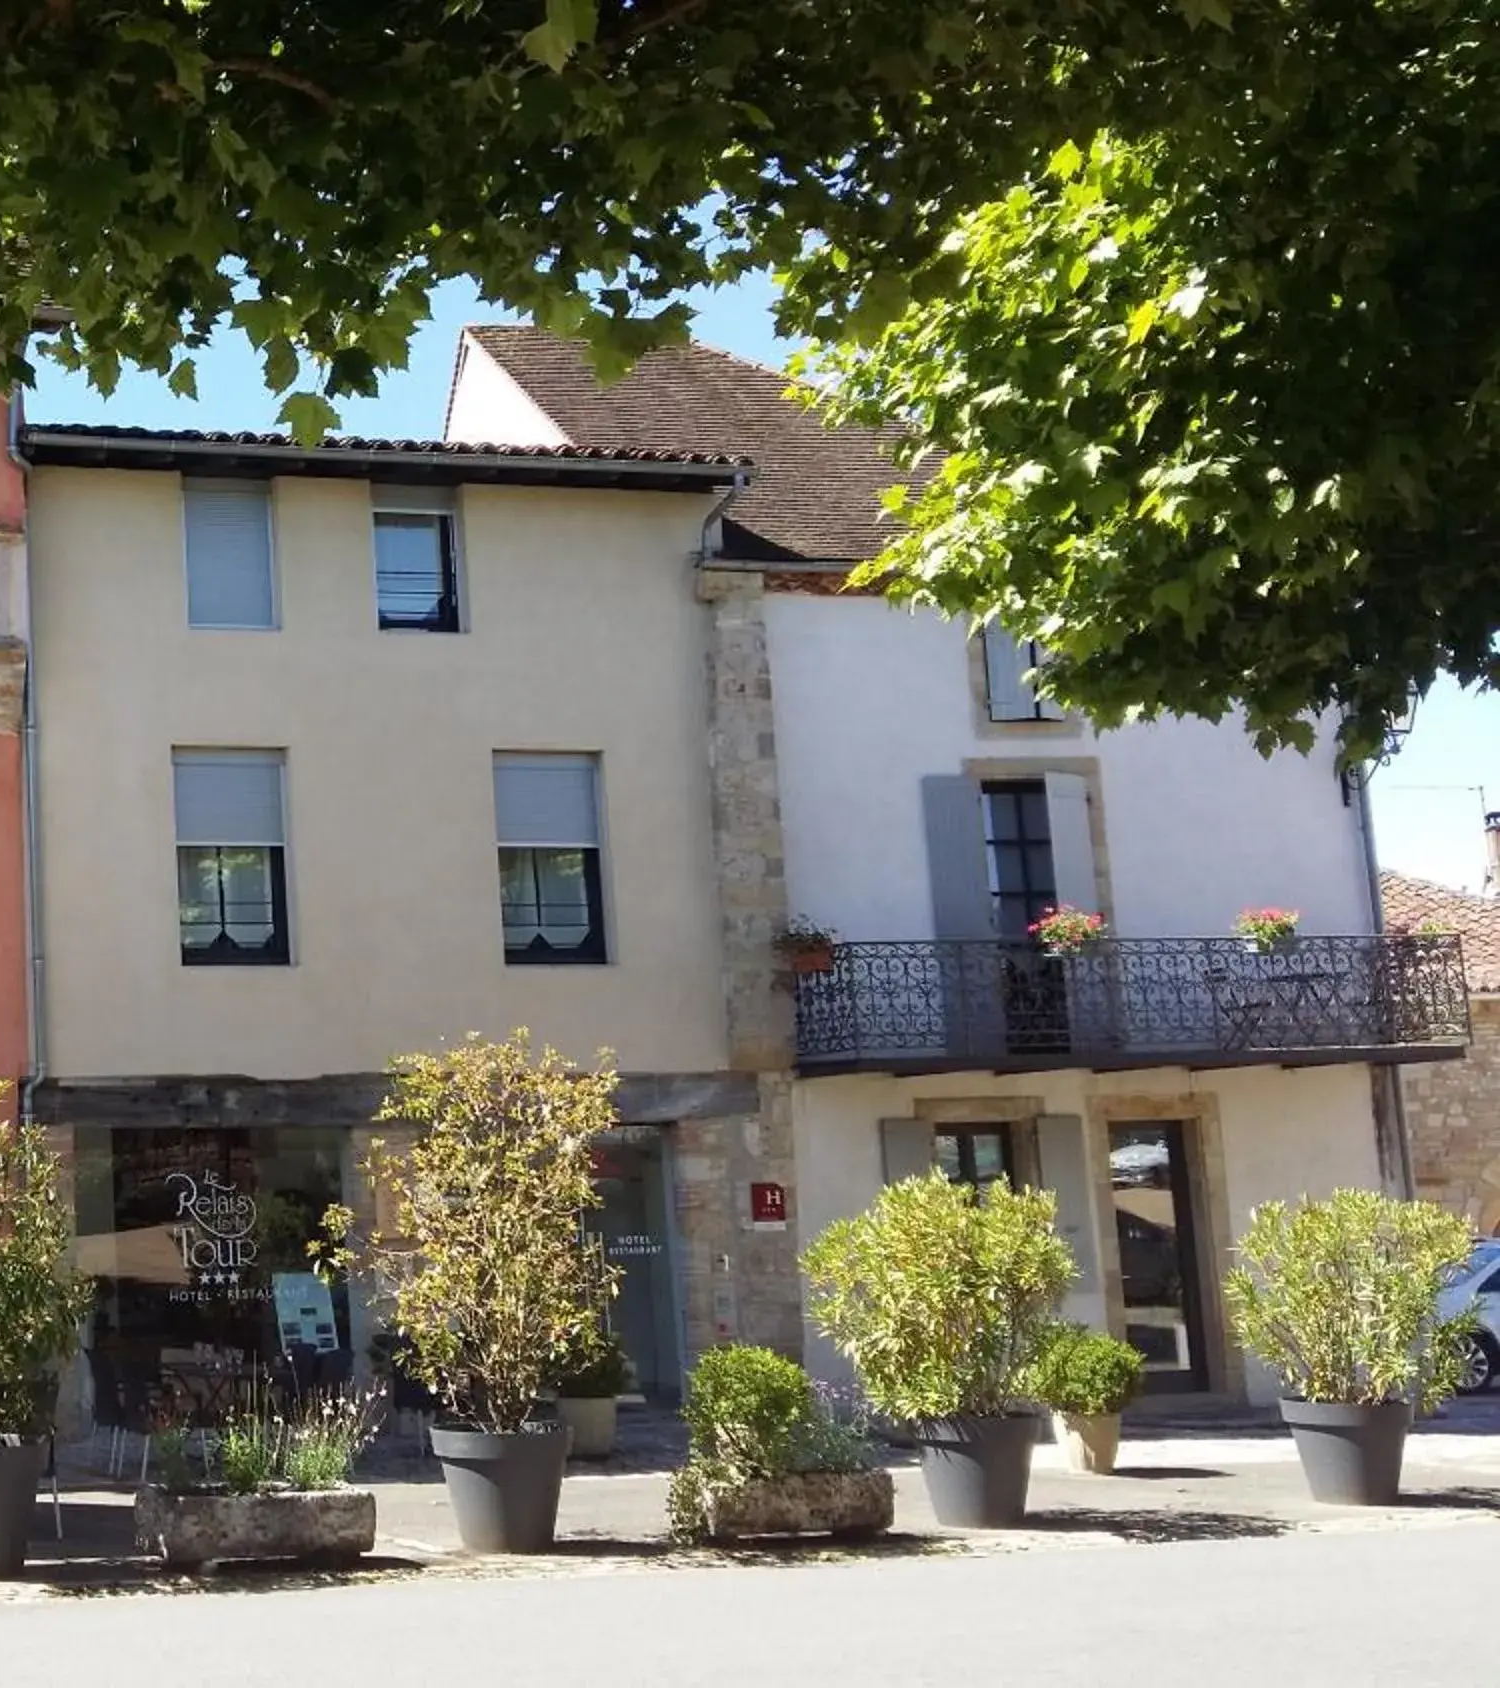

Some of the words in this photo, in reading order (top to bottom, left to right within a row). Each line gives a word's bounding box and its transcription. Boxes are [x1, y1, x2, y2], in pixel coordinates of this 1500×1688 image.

[203, 1168, 232, 1188] Le
[164, 1173, 256, 1234] Relais
[766, 1190, 780, 1204] H
[616, 1235, 651, 1245] HOTEL
[168, 1287, 212, 1302] HOTEL
